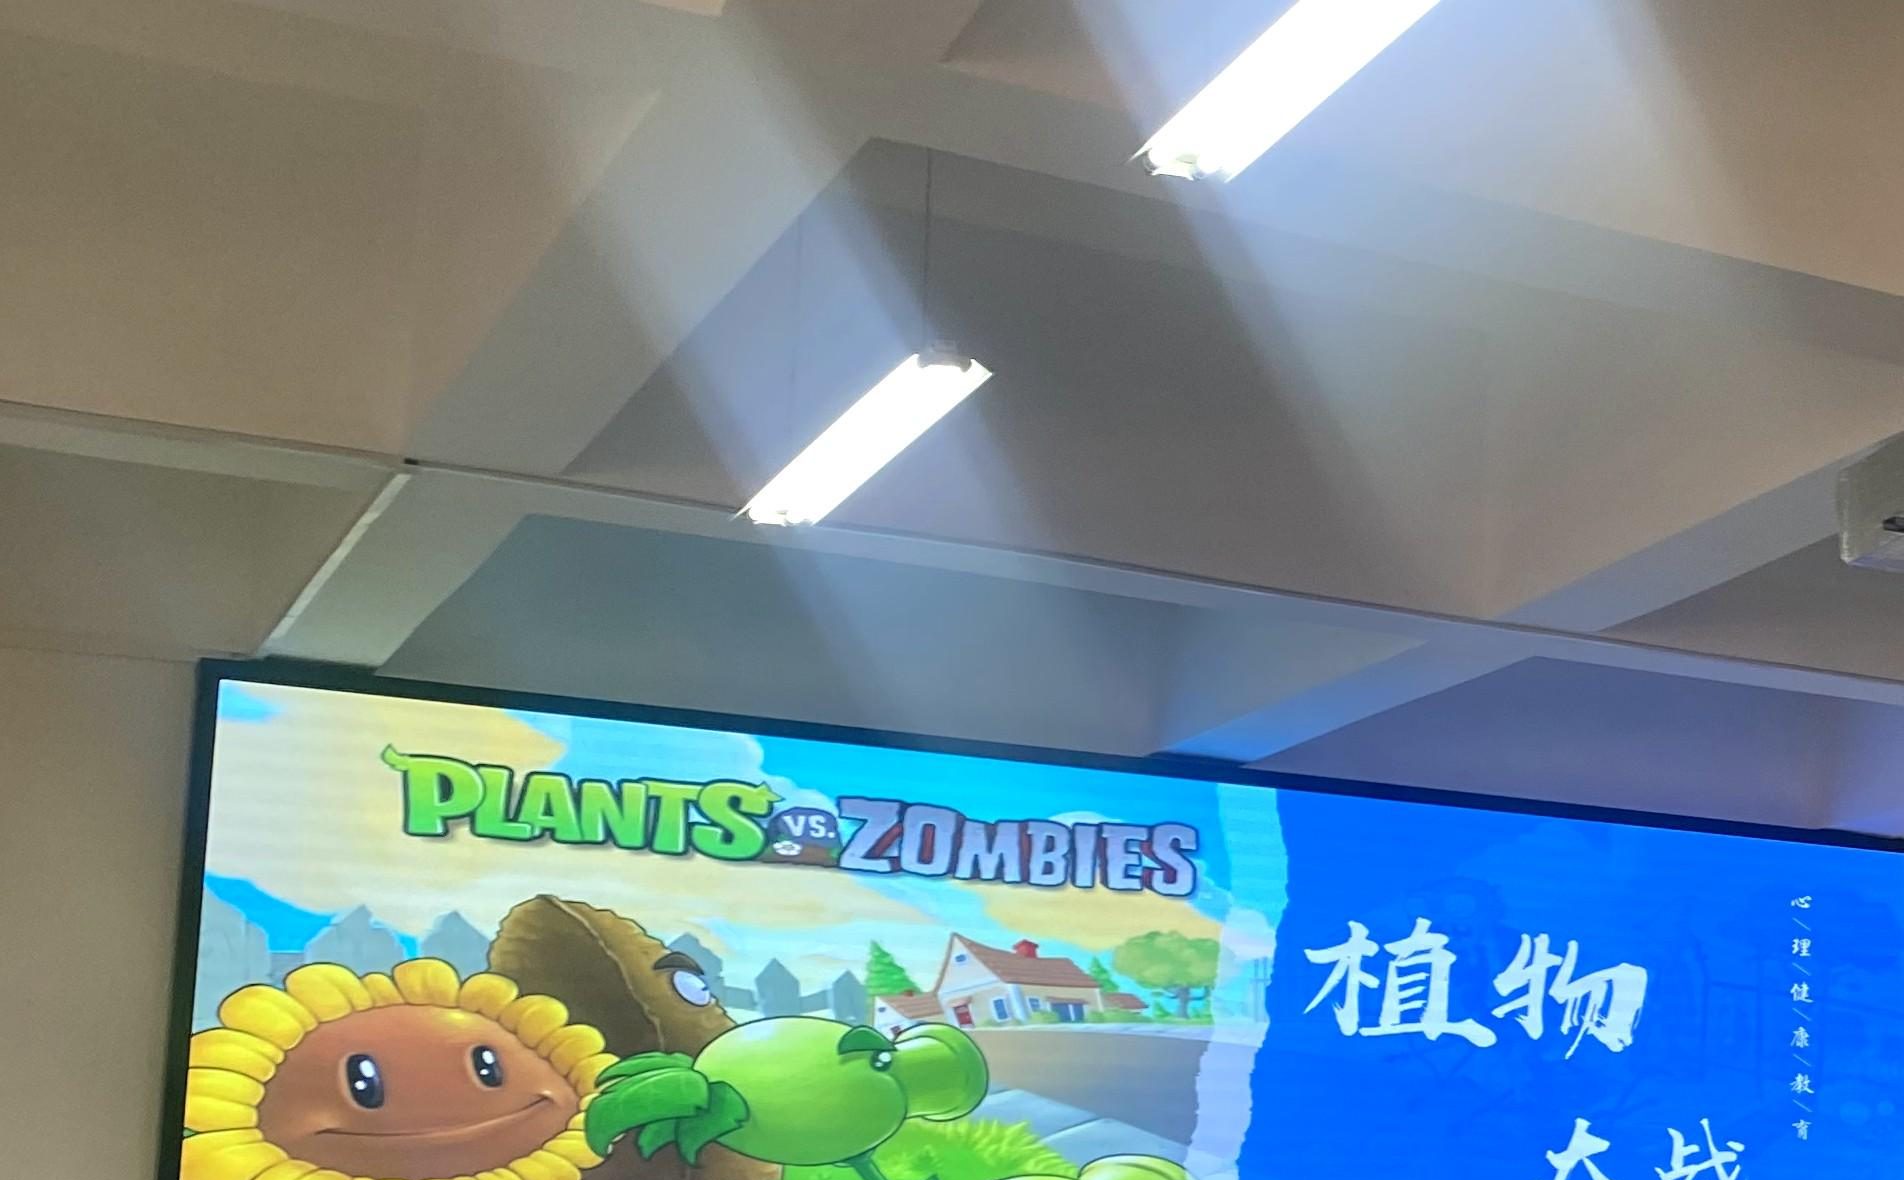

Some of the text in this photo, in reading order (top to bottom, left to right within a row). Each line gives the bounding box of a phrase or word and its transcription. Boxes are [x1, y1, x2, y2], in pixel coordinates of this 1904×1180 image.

[382, 744, 785, 862] PLANTS
[836, 796, 1199, 897] ZOMBIES
[1303, 917, 1648, 1059] 植物
